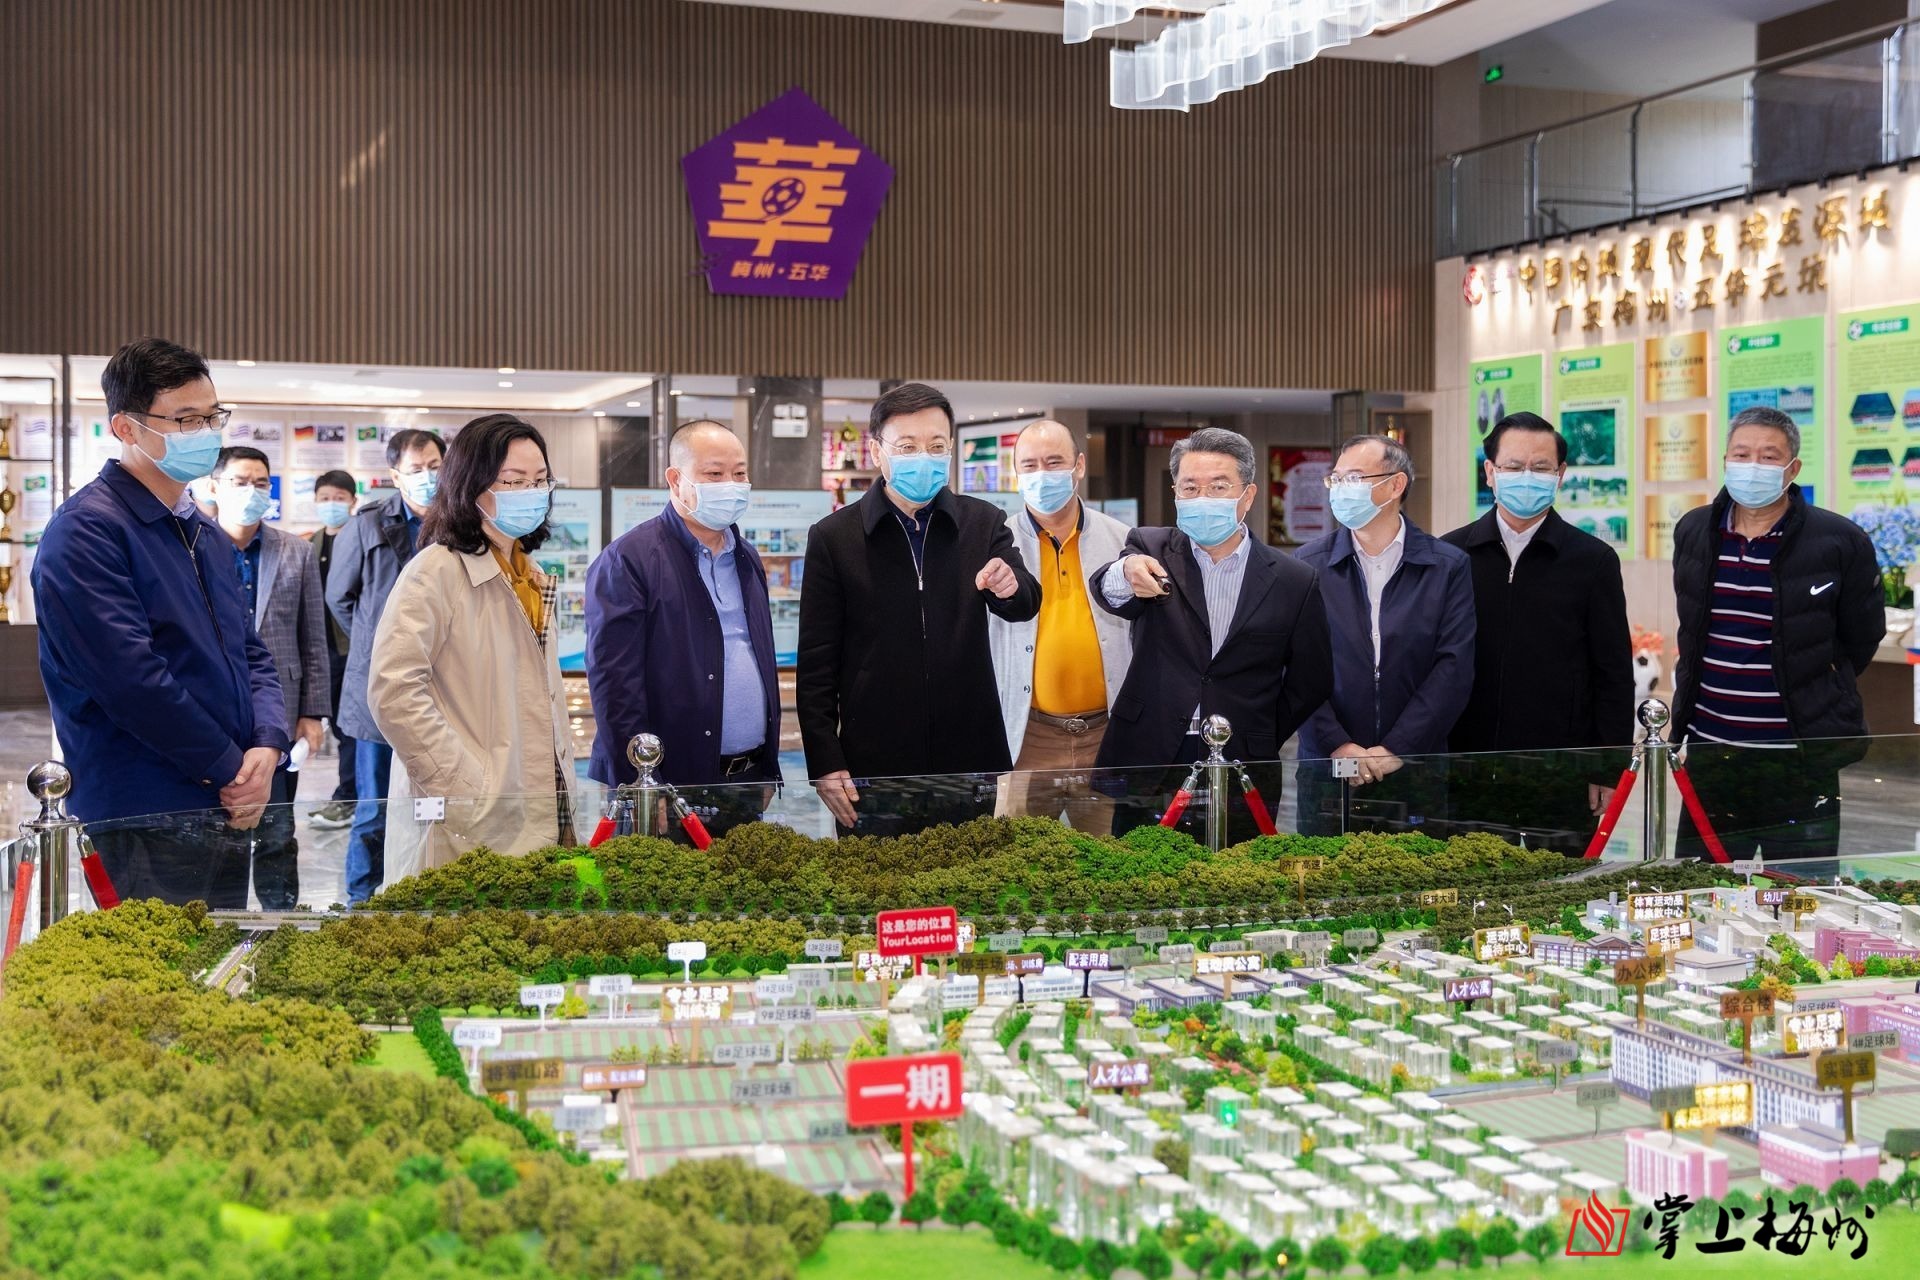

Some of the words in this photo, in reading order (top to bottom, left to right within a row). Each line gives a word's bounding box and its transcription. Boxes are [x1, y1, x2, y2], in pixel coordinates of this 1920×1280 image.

[1423, 892, 1457, 905] 足球大道
[882, 916, 952, 934] 这是您的位置
[882, 933, 953, 947] YourLocation
[1486, 927, 1521, 944] 运动员
[962, 957, 1004, 971] 停车场
[1068, 953, 1109, 967] 配套用房
[1618, 962, 1662, 982] 办公楼
[1448, 979, 1491, 999] 人才公寓
[1725, 993, 1772, 1013] 综合楼
[761, 1008, 812, 1021] 9#足球场
[1852, 1033, 1896, 1049] 4#足球场
[717, 1045, 771, 1059] 8#足球场
[1093, 1063, 1149, 1087] 人才公寓
[1823, 1058, 1870, 1080] 实验室
[735, 1082, 792, 1097] 7#足球场
[860, 1063, 952, 1110] 一期
